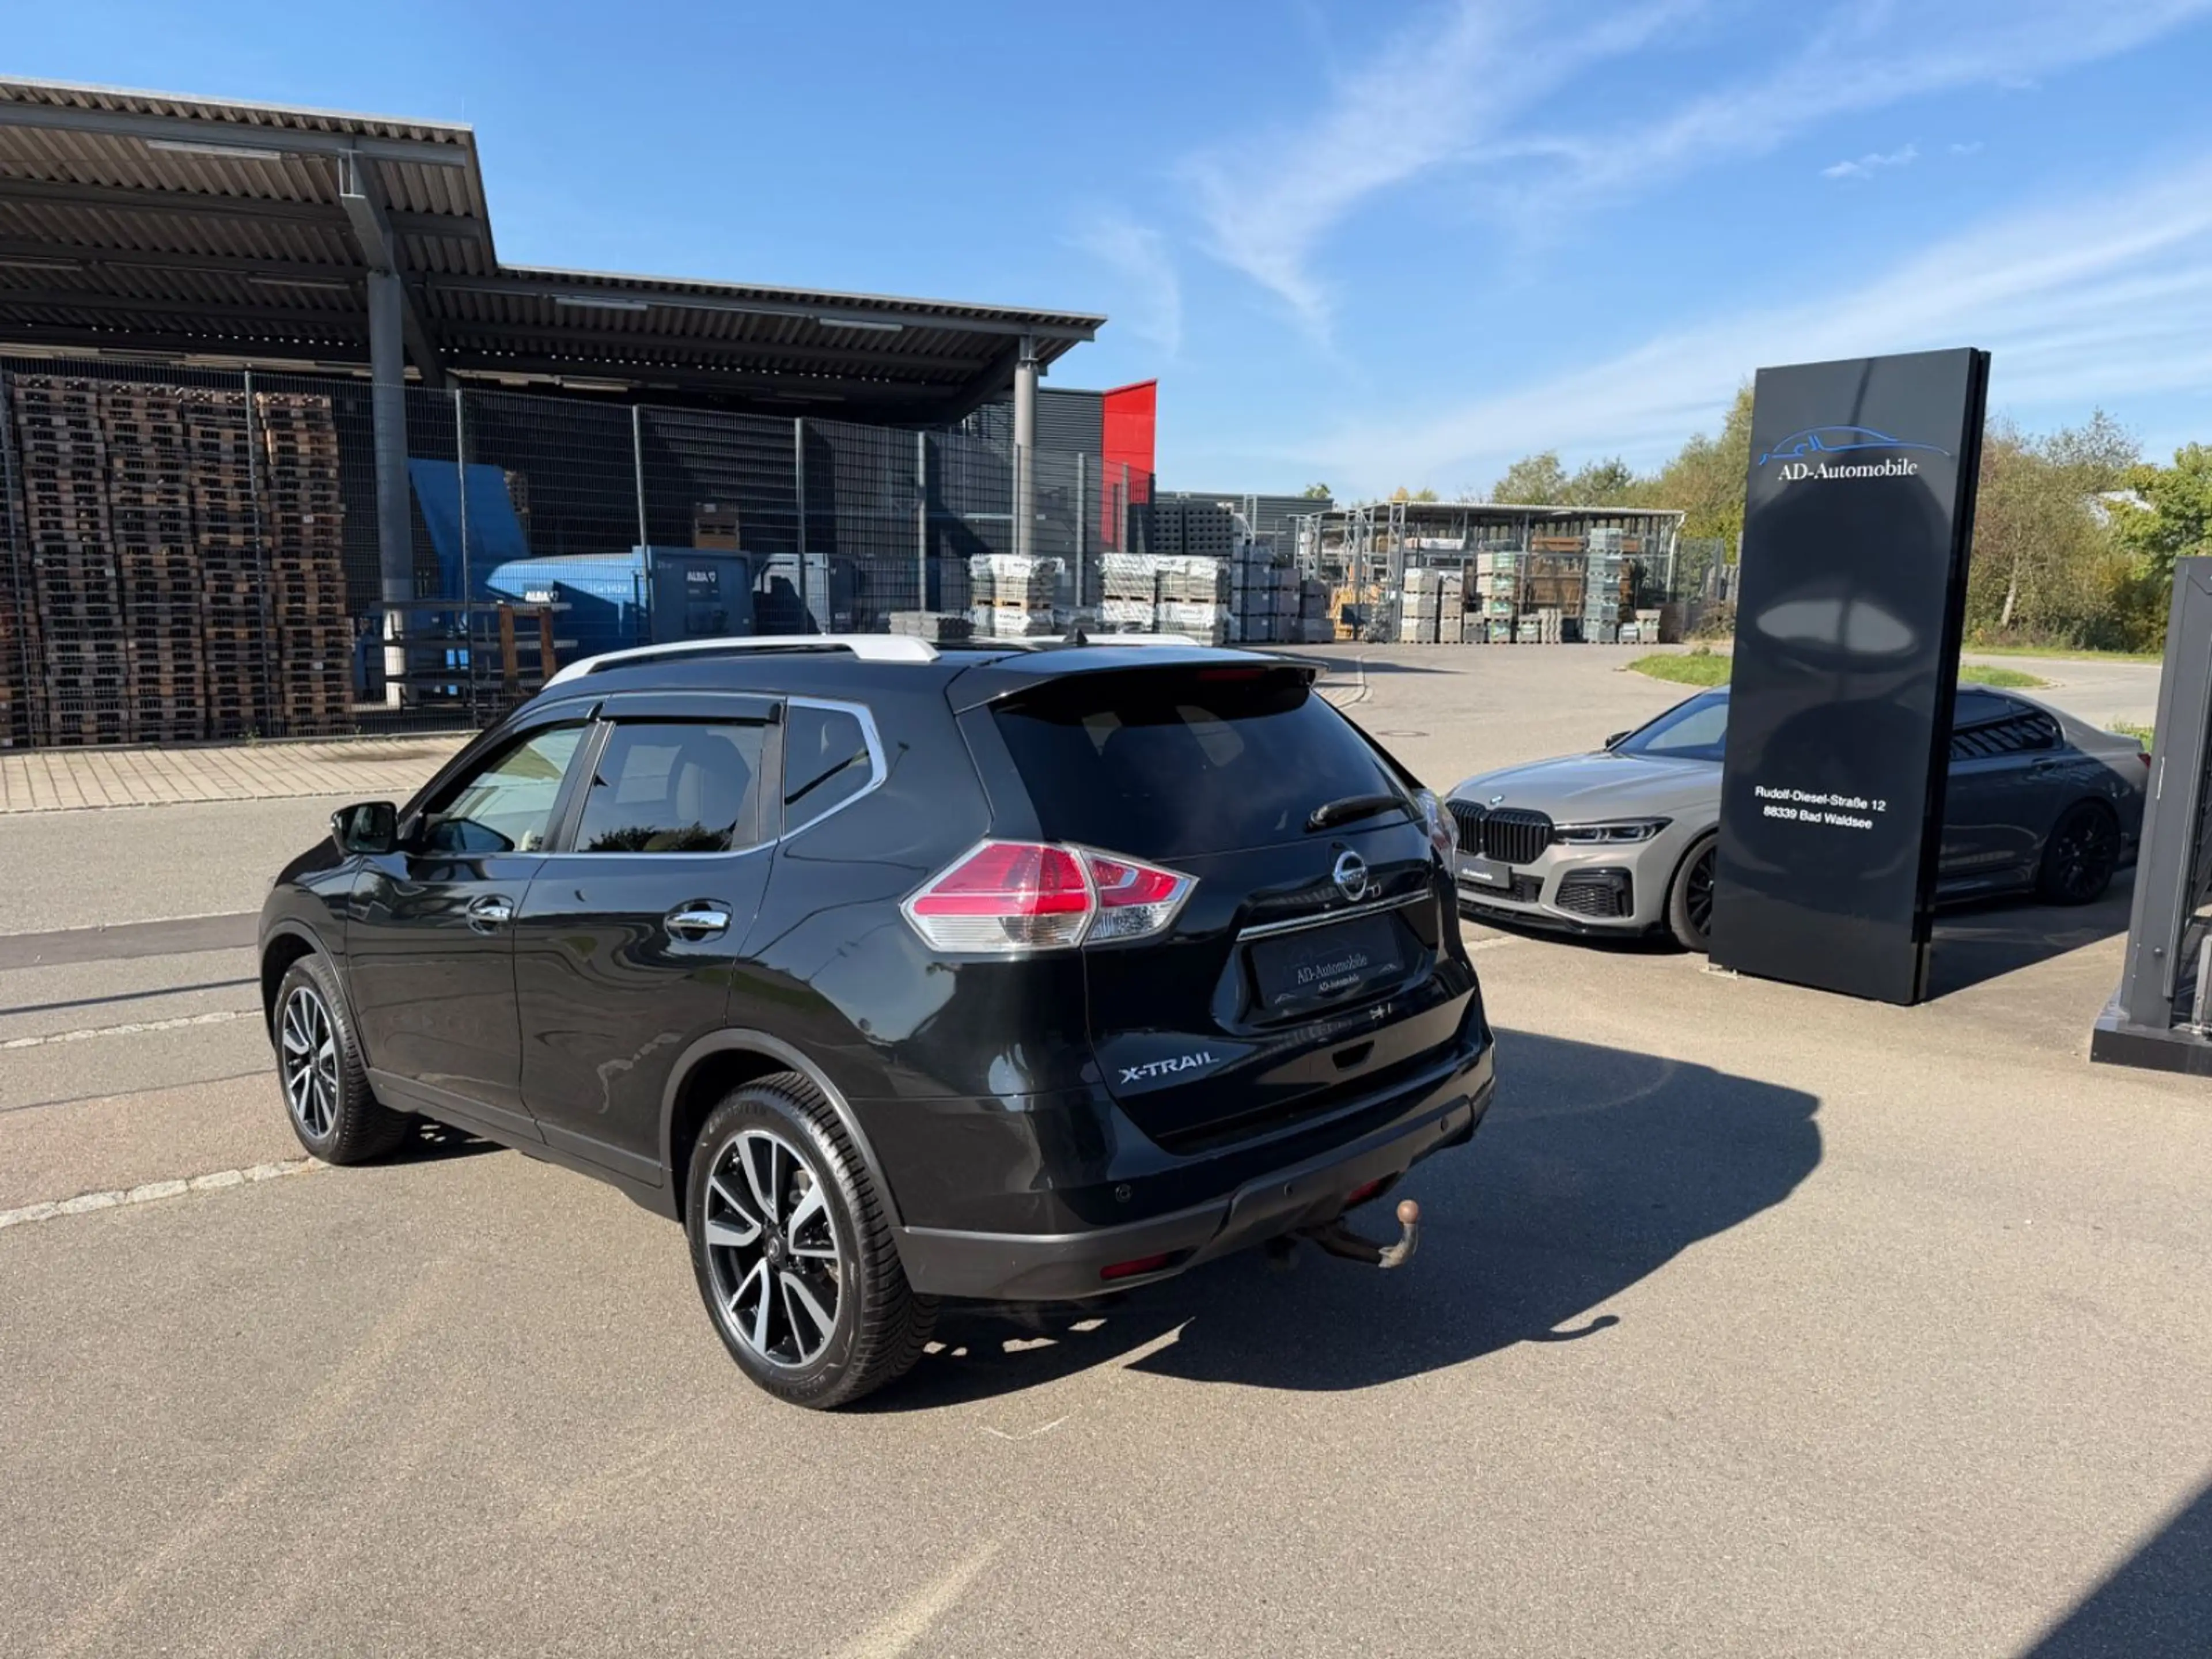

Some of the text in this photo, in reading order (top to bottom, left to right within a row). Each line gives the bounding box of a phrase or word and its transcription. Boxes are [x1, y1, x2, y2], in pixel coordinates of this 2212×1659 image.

[1778, 459, 1918, 481] AD-Automobile
[1755, 785, 1887, 812] Rudolf-Diesel-Straße 12
[1763, 805, 1873, 830] 88339 Bad Waldsee
[1118, 1051, 1221, 1085] X-TRAIL
